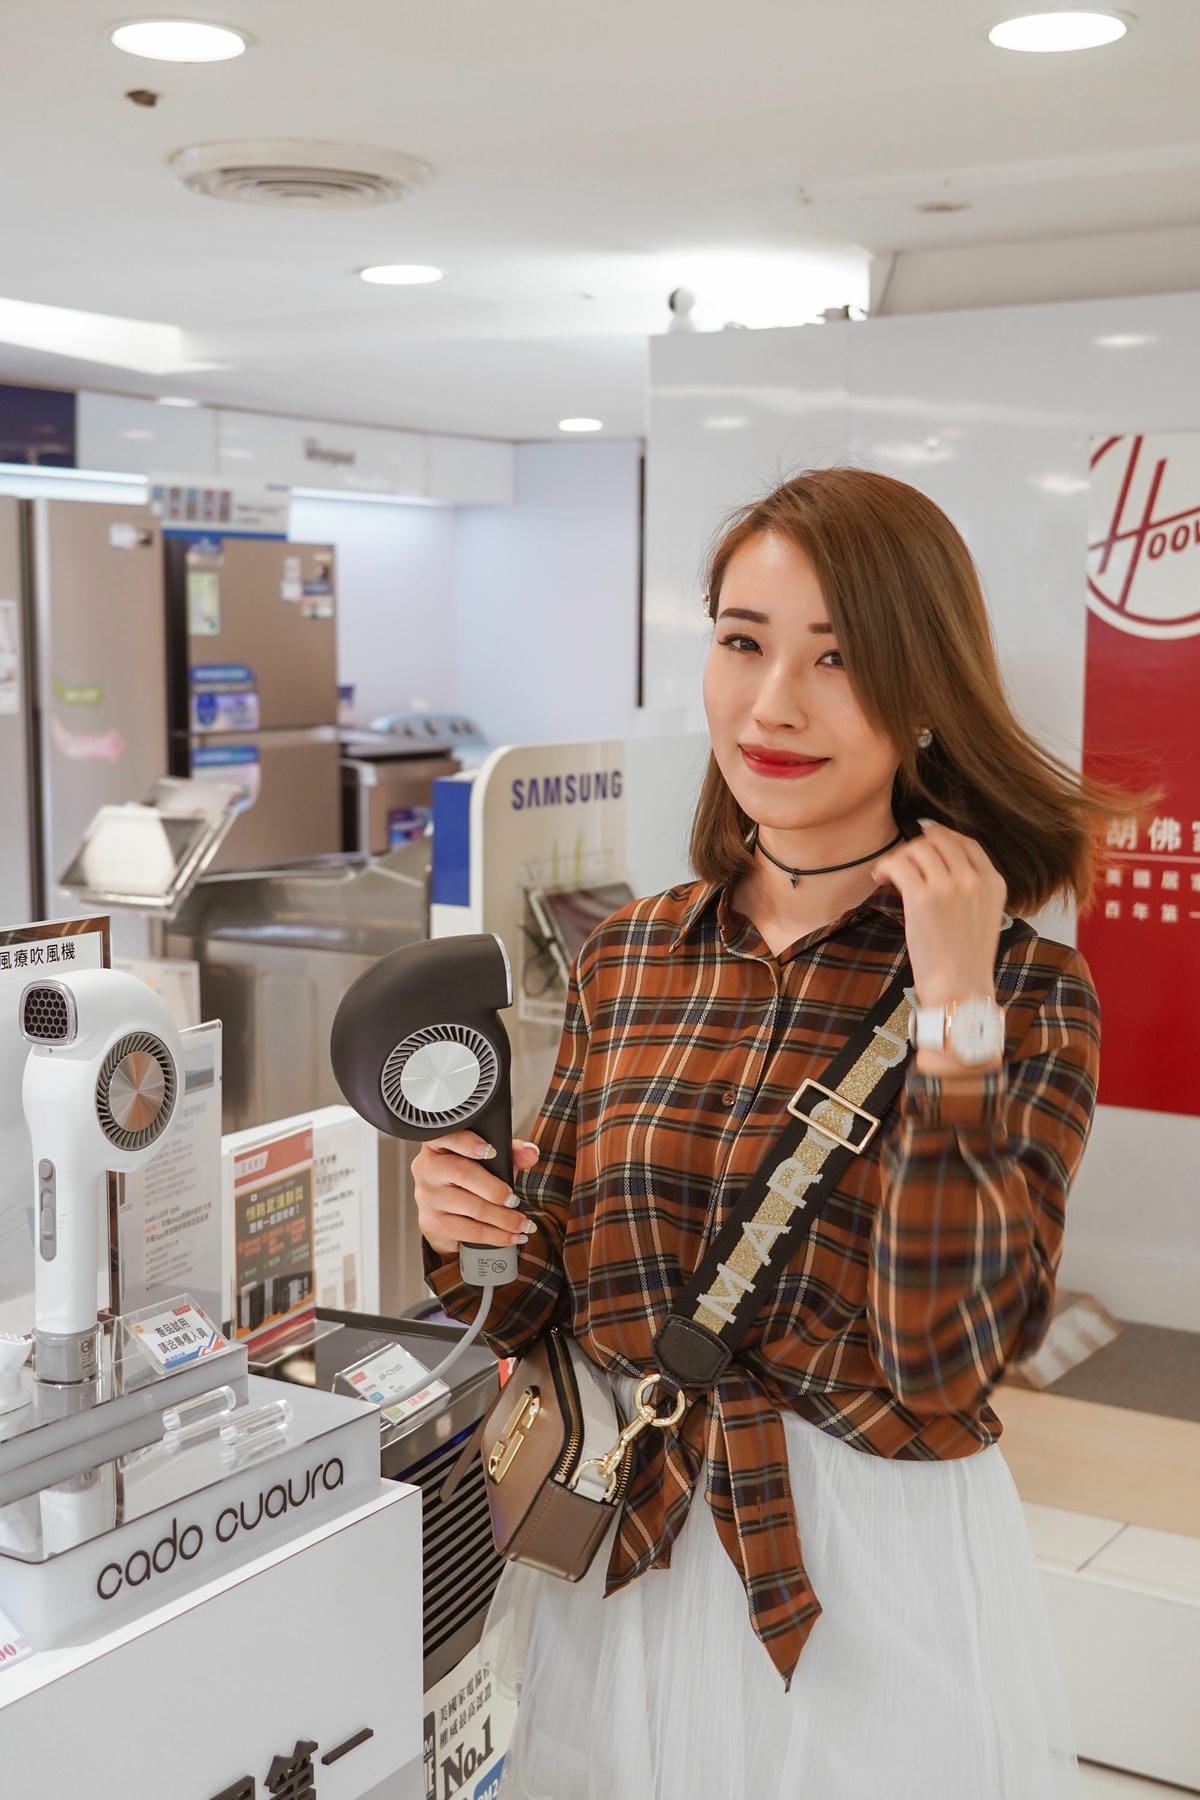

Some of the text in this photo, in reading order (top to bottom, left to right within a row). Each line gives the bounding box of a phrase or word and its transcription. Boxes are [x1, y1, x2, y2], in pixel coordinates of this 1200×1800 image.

[511, 769, 622, 811] SAMSUNG
[0, 941, 75, 970] 風療吹風機
[154, 1317, 191, 1337] 產品試用
[157, 1327, 208, 1354] 請洽專櫃人員
[96, 1457, 344, 1600] cado cuaura
[440, 1713, 494, 1800] No.1
